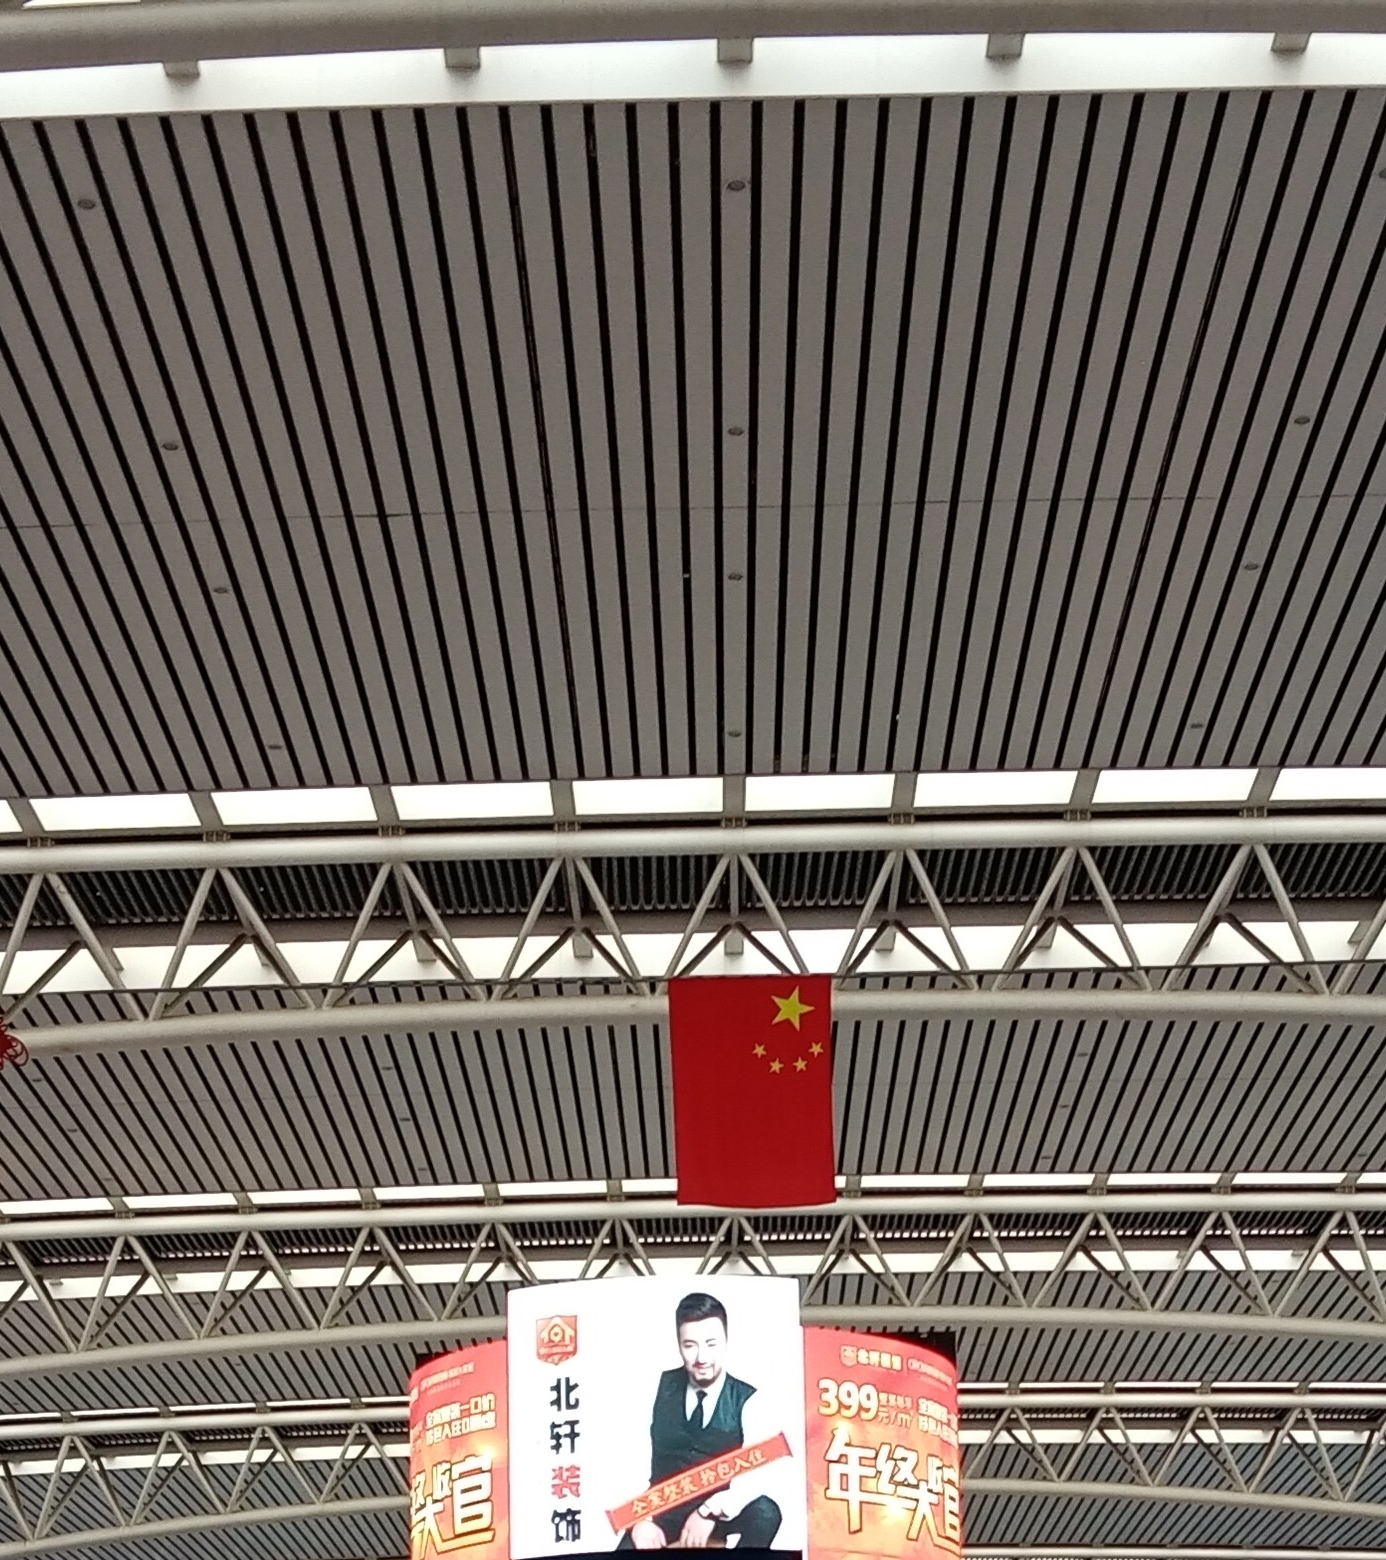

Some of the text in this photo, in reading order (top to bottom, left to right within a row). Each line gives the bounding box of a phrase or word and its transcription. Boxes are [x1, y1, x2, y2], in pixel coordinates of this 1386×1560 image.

[817, 1377, 879, 1422] 399
[549, 1376, 582, 1544] 北轩装饰
[700, 1448, 767, 1487] 拎包入住
